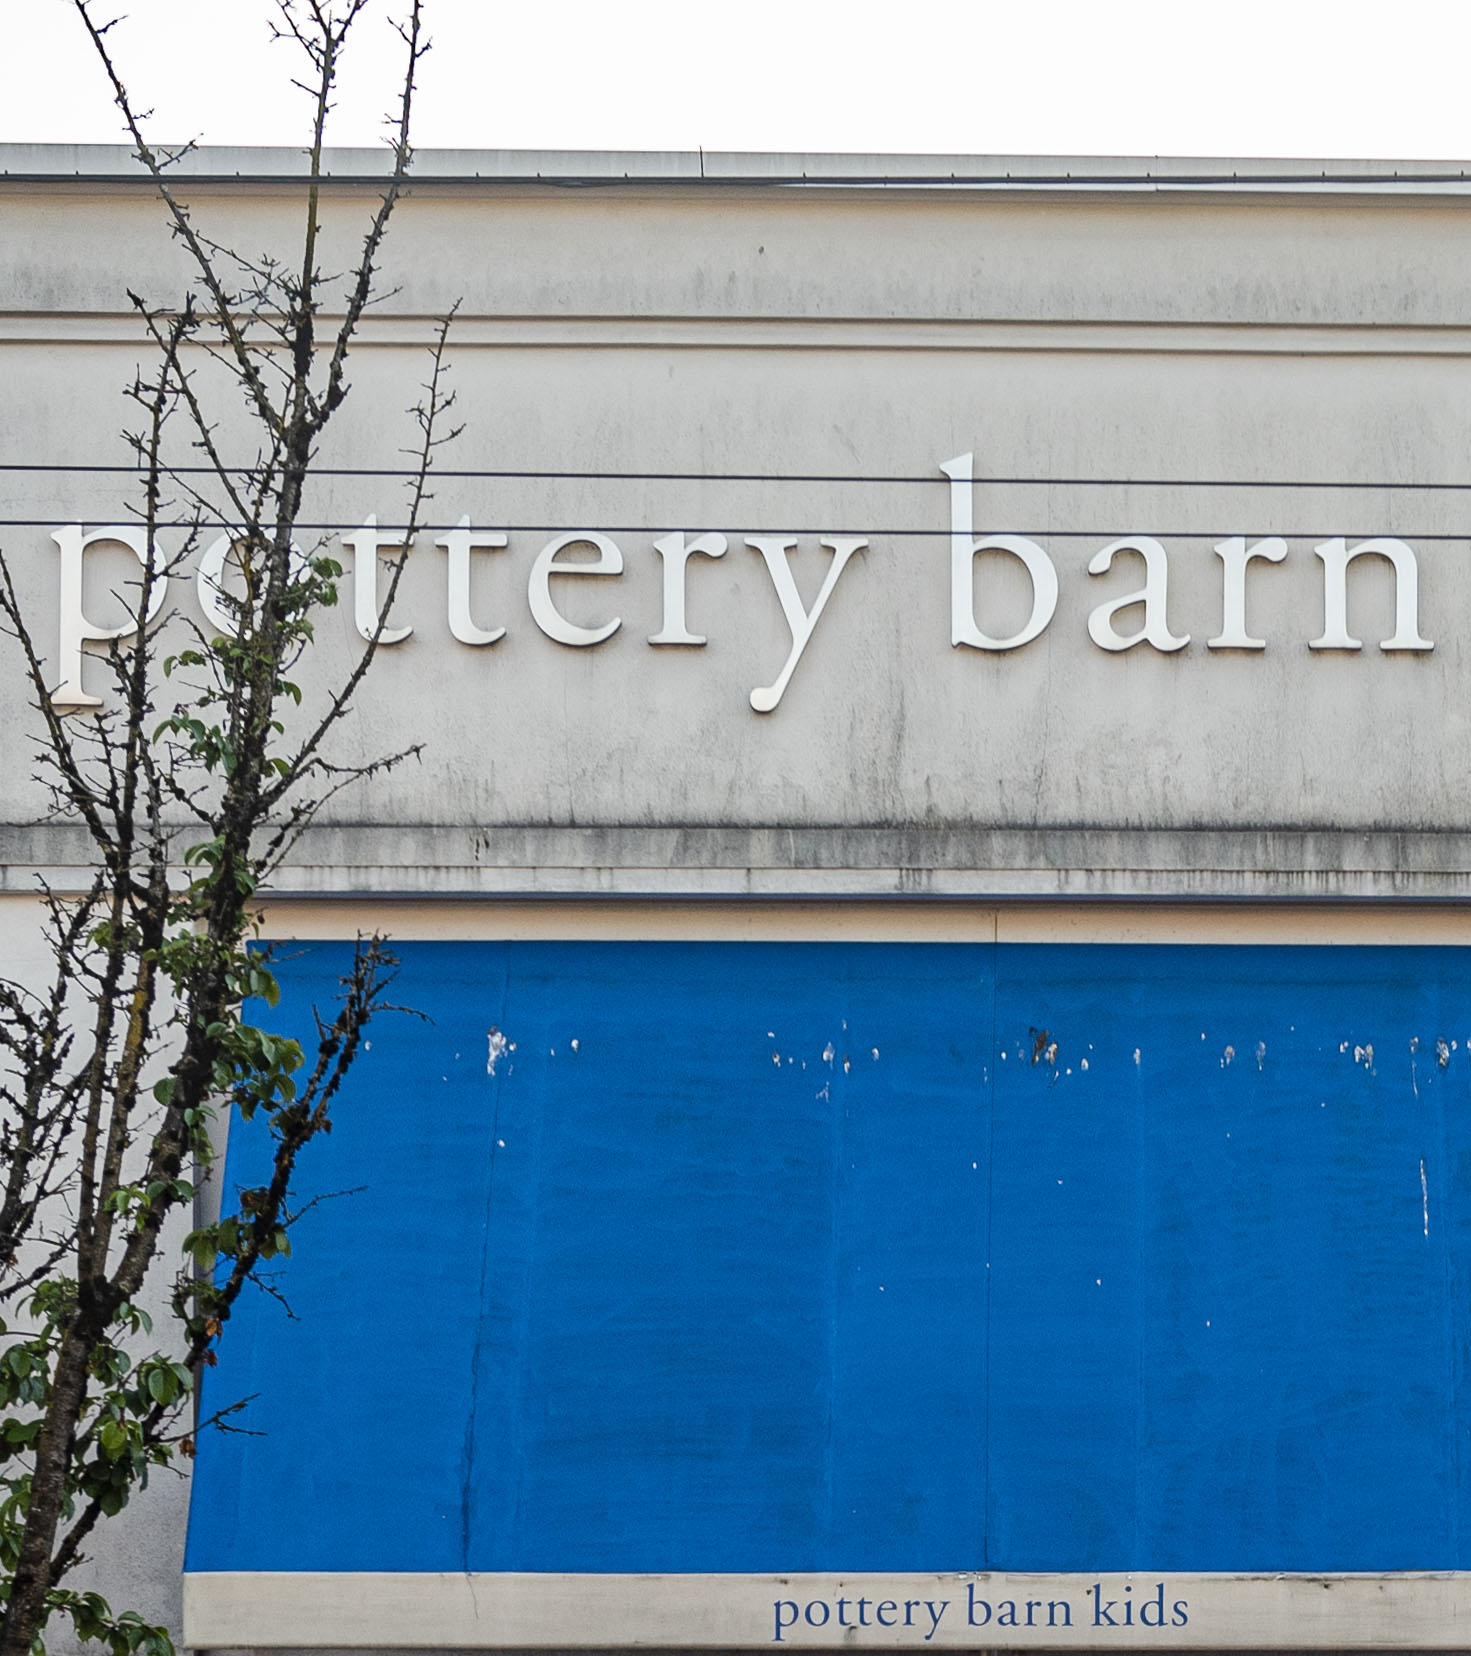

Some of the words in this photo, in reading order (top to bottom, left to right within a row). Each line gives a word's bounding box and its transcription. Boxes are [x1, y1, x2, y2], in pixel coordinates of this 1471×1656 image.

[50, 513, 869, 713] pottery
[940, 452, 1436, 653] barn
[772, 1593, 950, 1641] pottery
[967, 1583, 1075, 1628] barn
[1091, 1583, 1190, 1628] kids
